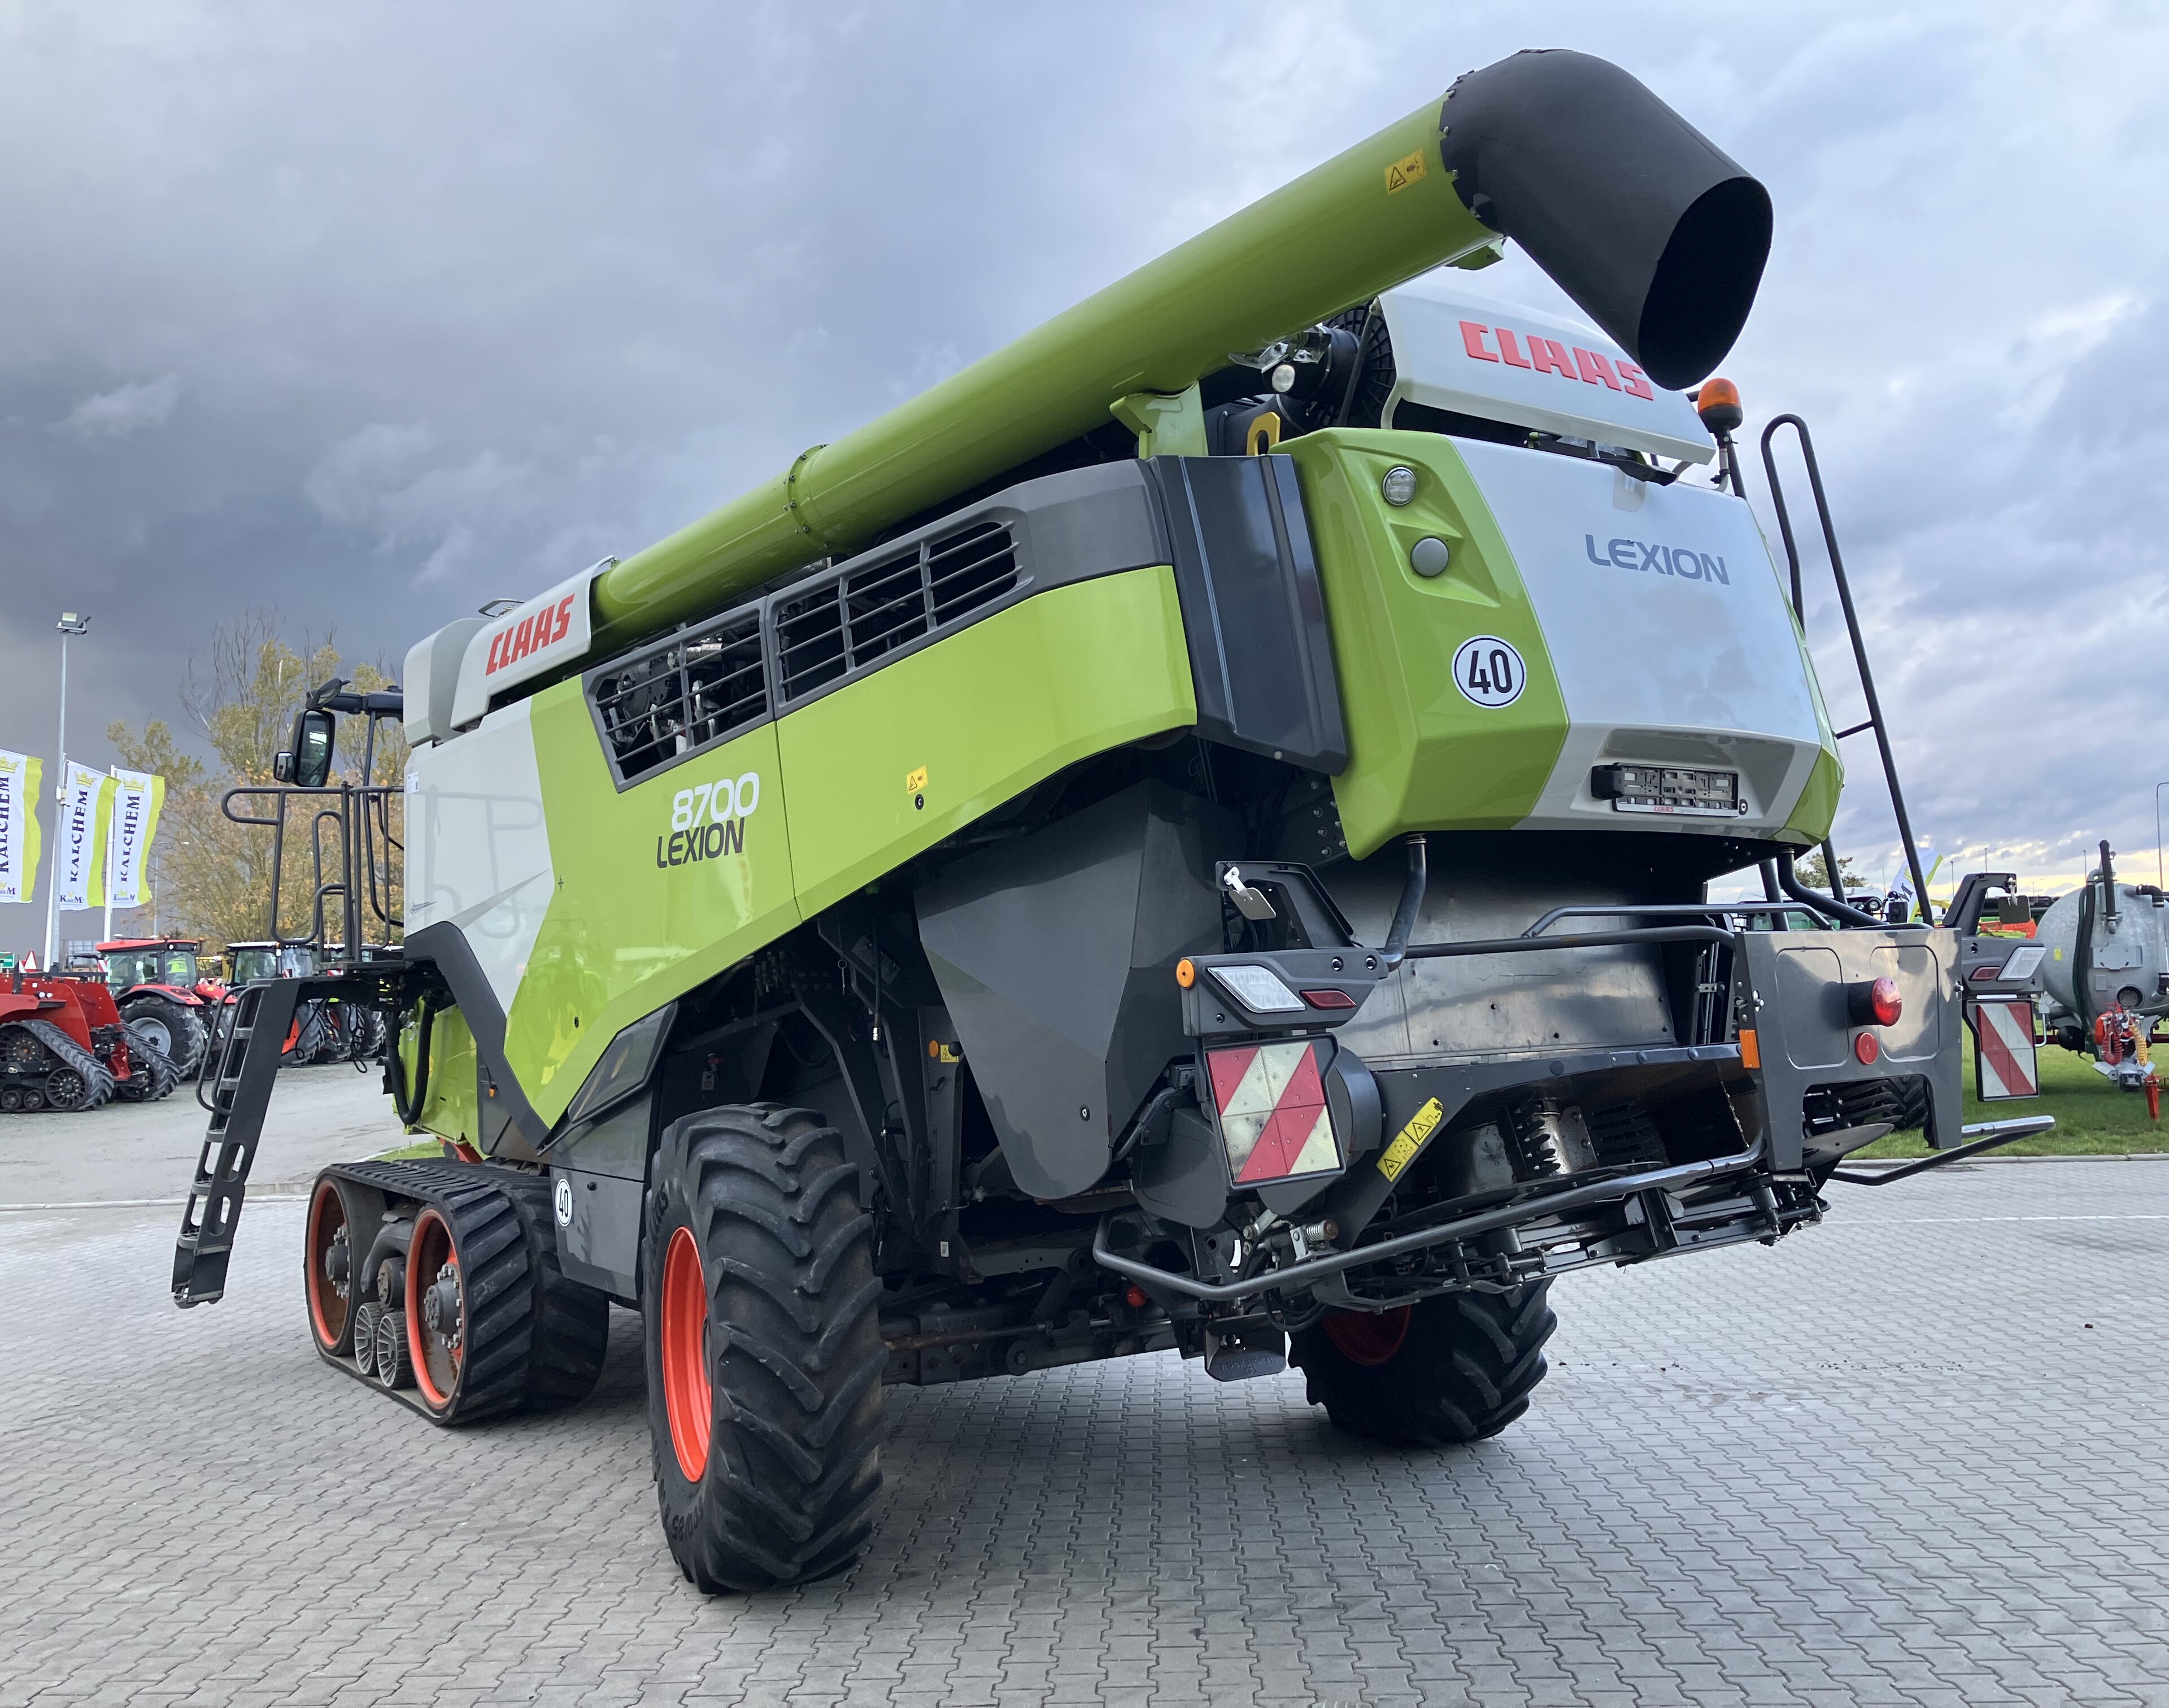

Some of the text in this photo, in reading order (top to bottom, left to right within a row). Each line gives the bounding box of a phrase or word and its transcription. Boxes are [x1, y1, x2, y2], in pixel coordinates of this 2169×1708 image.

[1458, 320, 1654, 401] CLAAS
[1585, 534, 1730, 585] LEXION
[485, 593, 576, 676] CLAAS
[1468, 649, 1513, 694] 40
[672, 772, 760, 833] 8700
[70, 790, 88, 882] KALCHEM
[120, 795, 140, 882] KALCHEM
[657, 817, 745, 868] LEXION
[1403, 1145, 1414, 1161] STOP
[559, 1188, 569, 1218] 40
